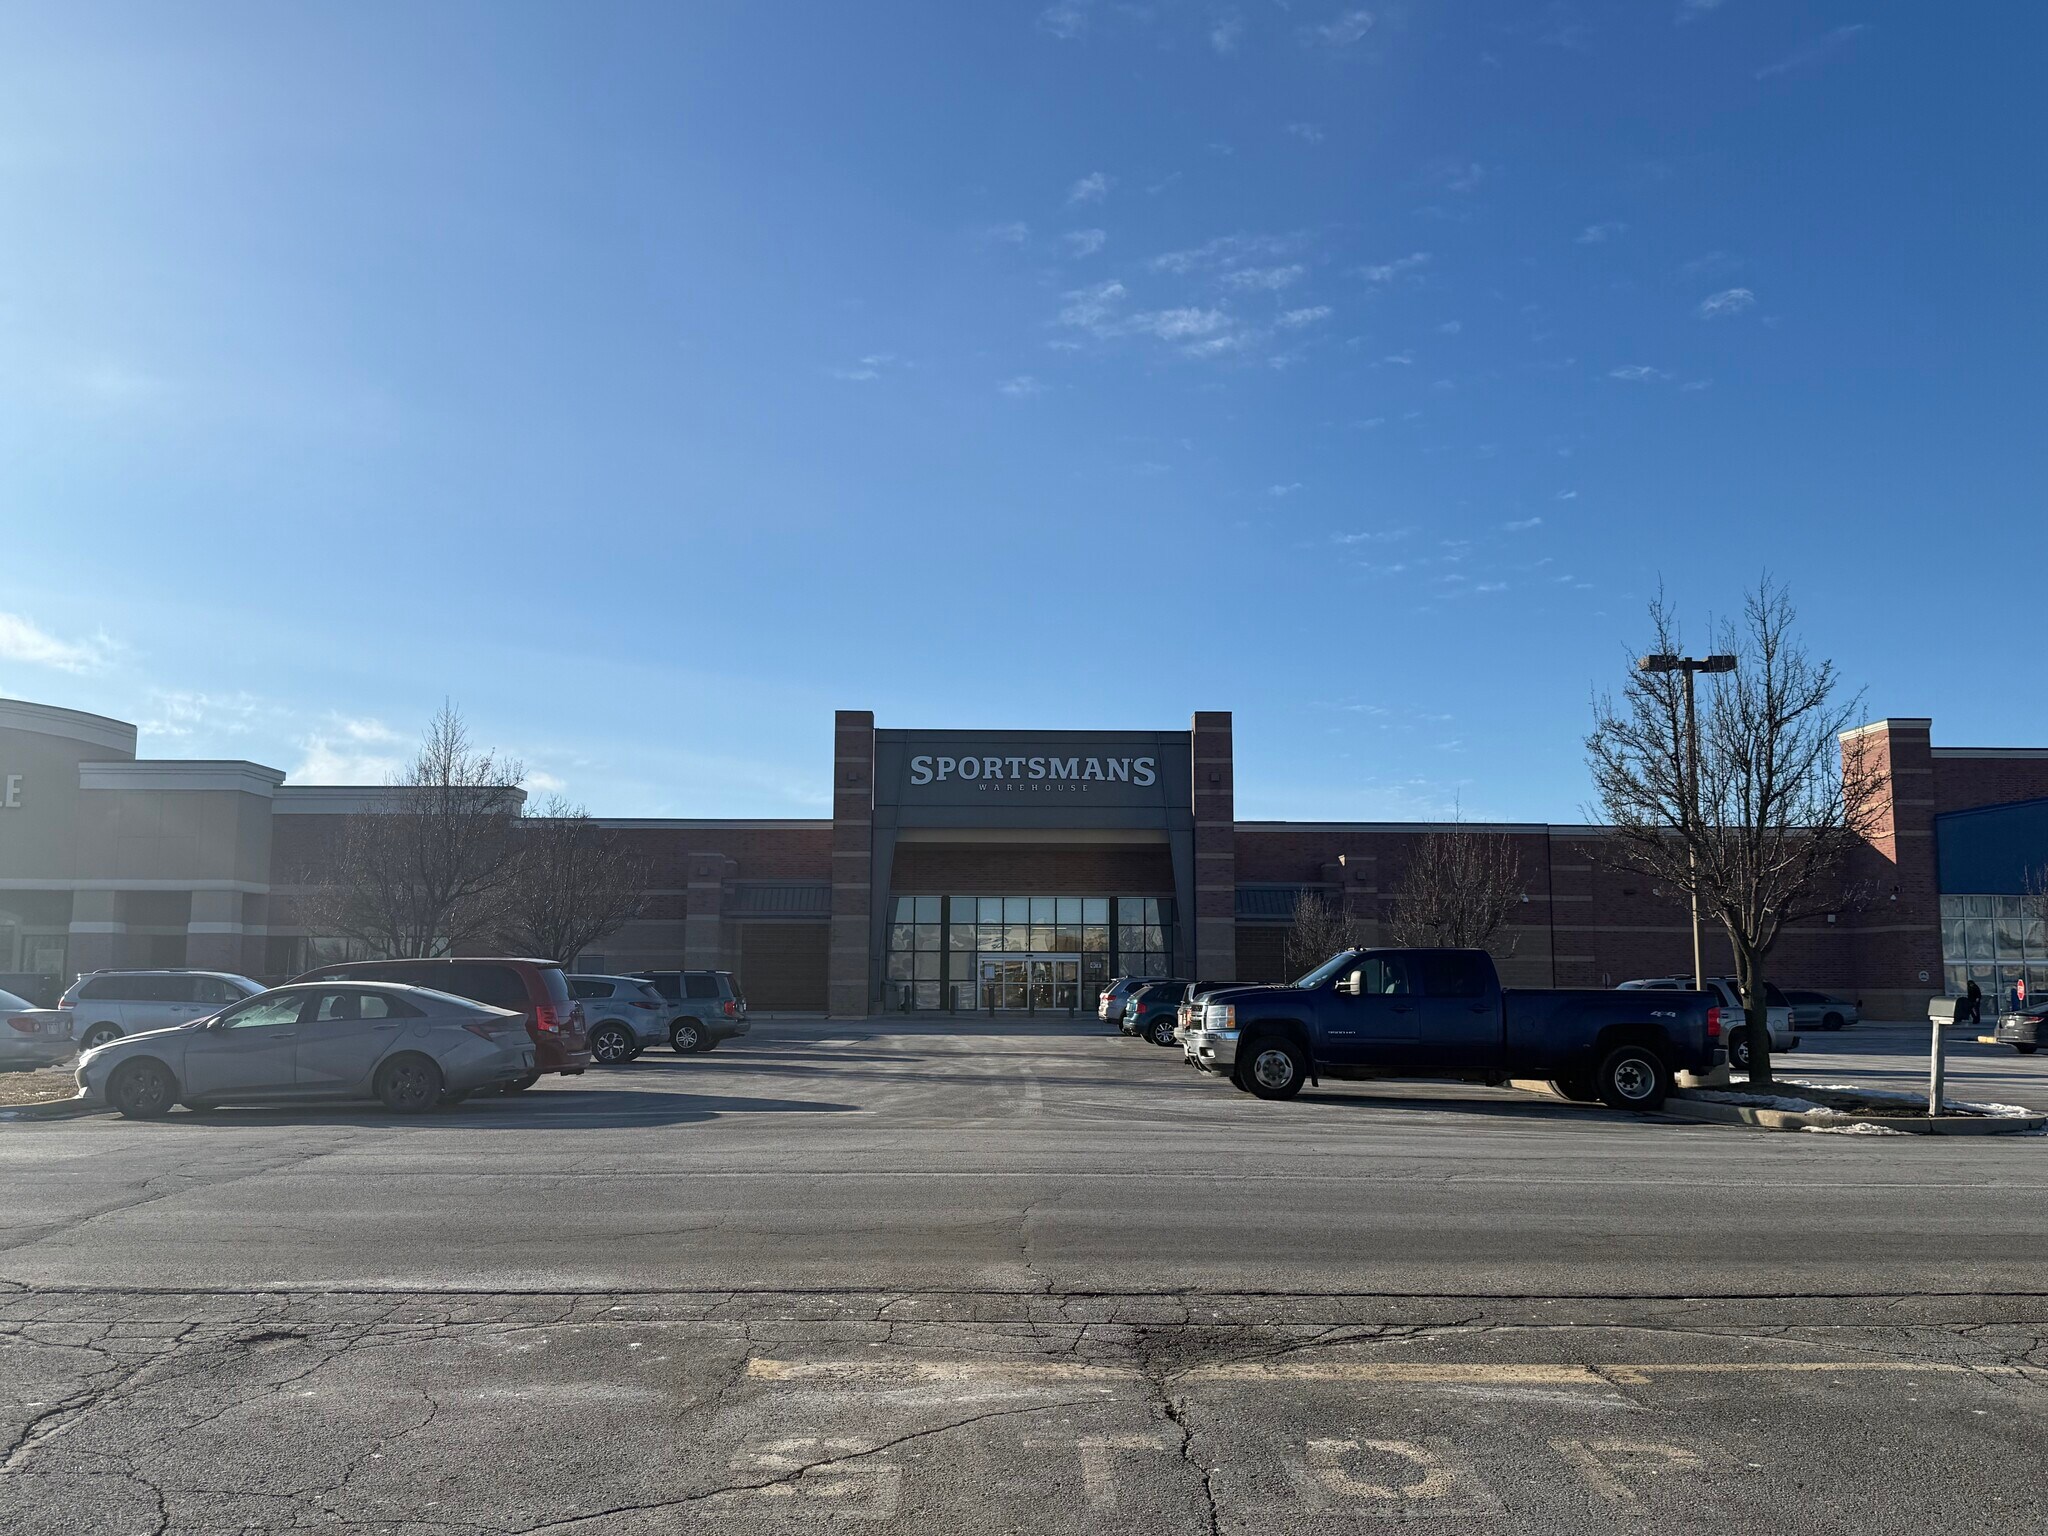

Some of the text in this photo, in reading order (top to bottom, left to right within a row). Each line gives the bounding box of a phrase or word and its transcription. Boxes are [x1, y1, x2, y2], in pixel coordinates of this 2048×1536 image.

[910, 755, 1156, 787] SPORTSMAN'S
[0, 774, 23, 807] E
[978, 784, 1089, 792] WAREHOUSE
